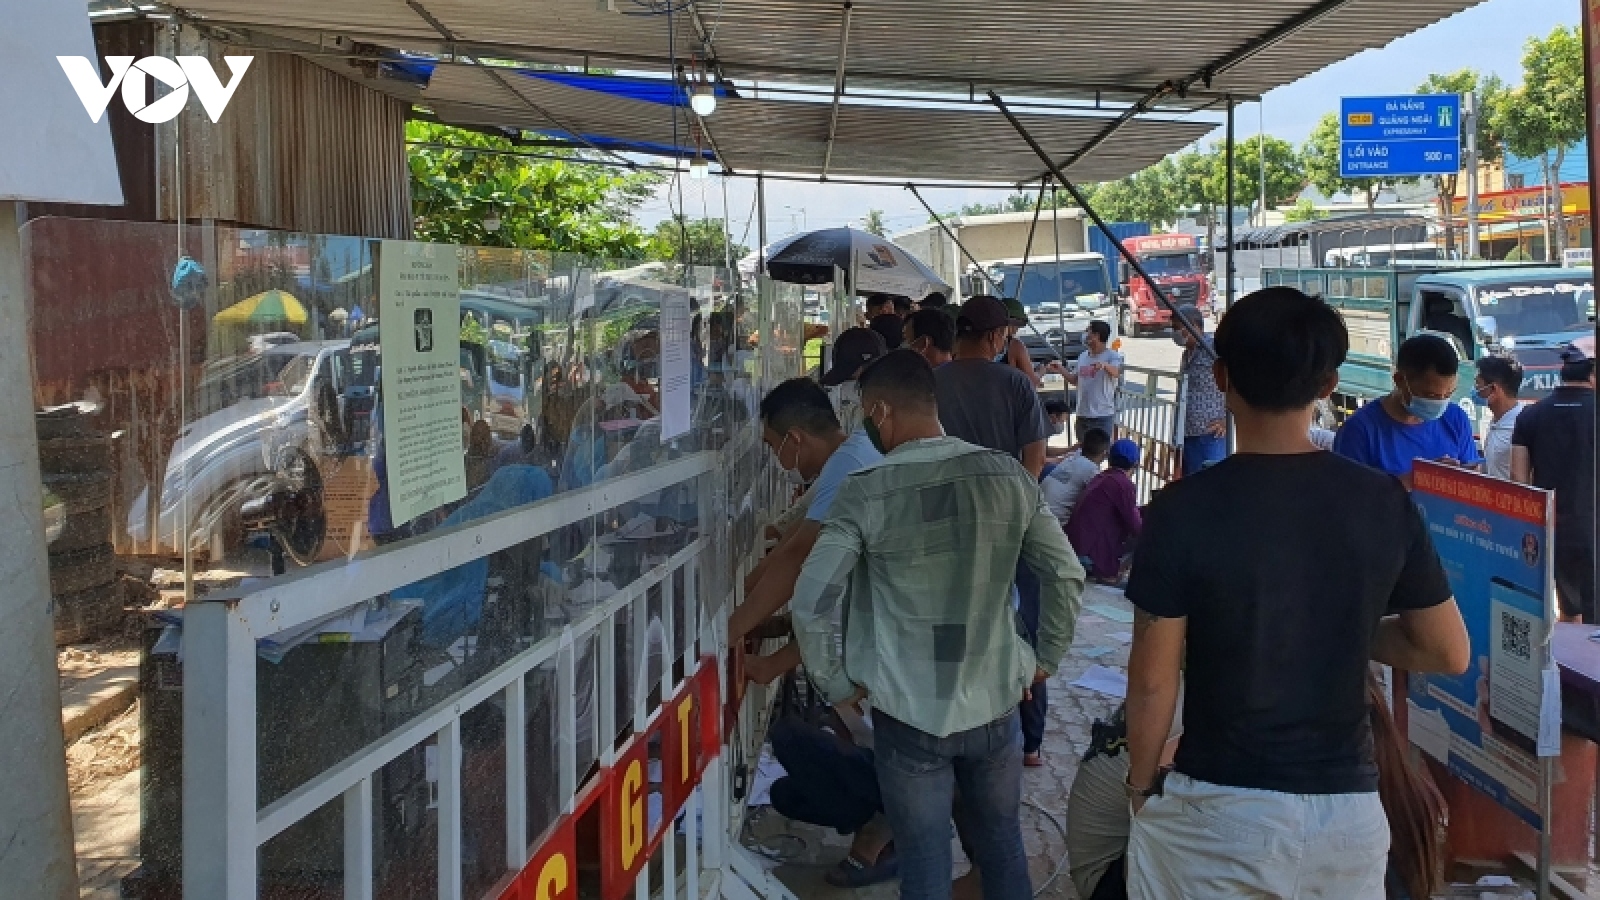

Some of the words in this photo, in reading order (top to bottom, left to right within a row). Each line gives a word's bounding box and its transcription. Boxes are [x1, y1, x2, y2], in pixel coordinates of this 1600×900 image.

[1348, 144, 1364, 157] LỐI
[1367, 144, 1388, 156] VÀO
[1424, 151, 1442, 161] 500
[1534, 374, 1561, 390] KIA
